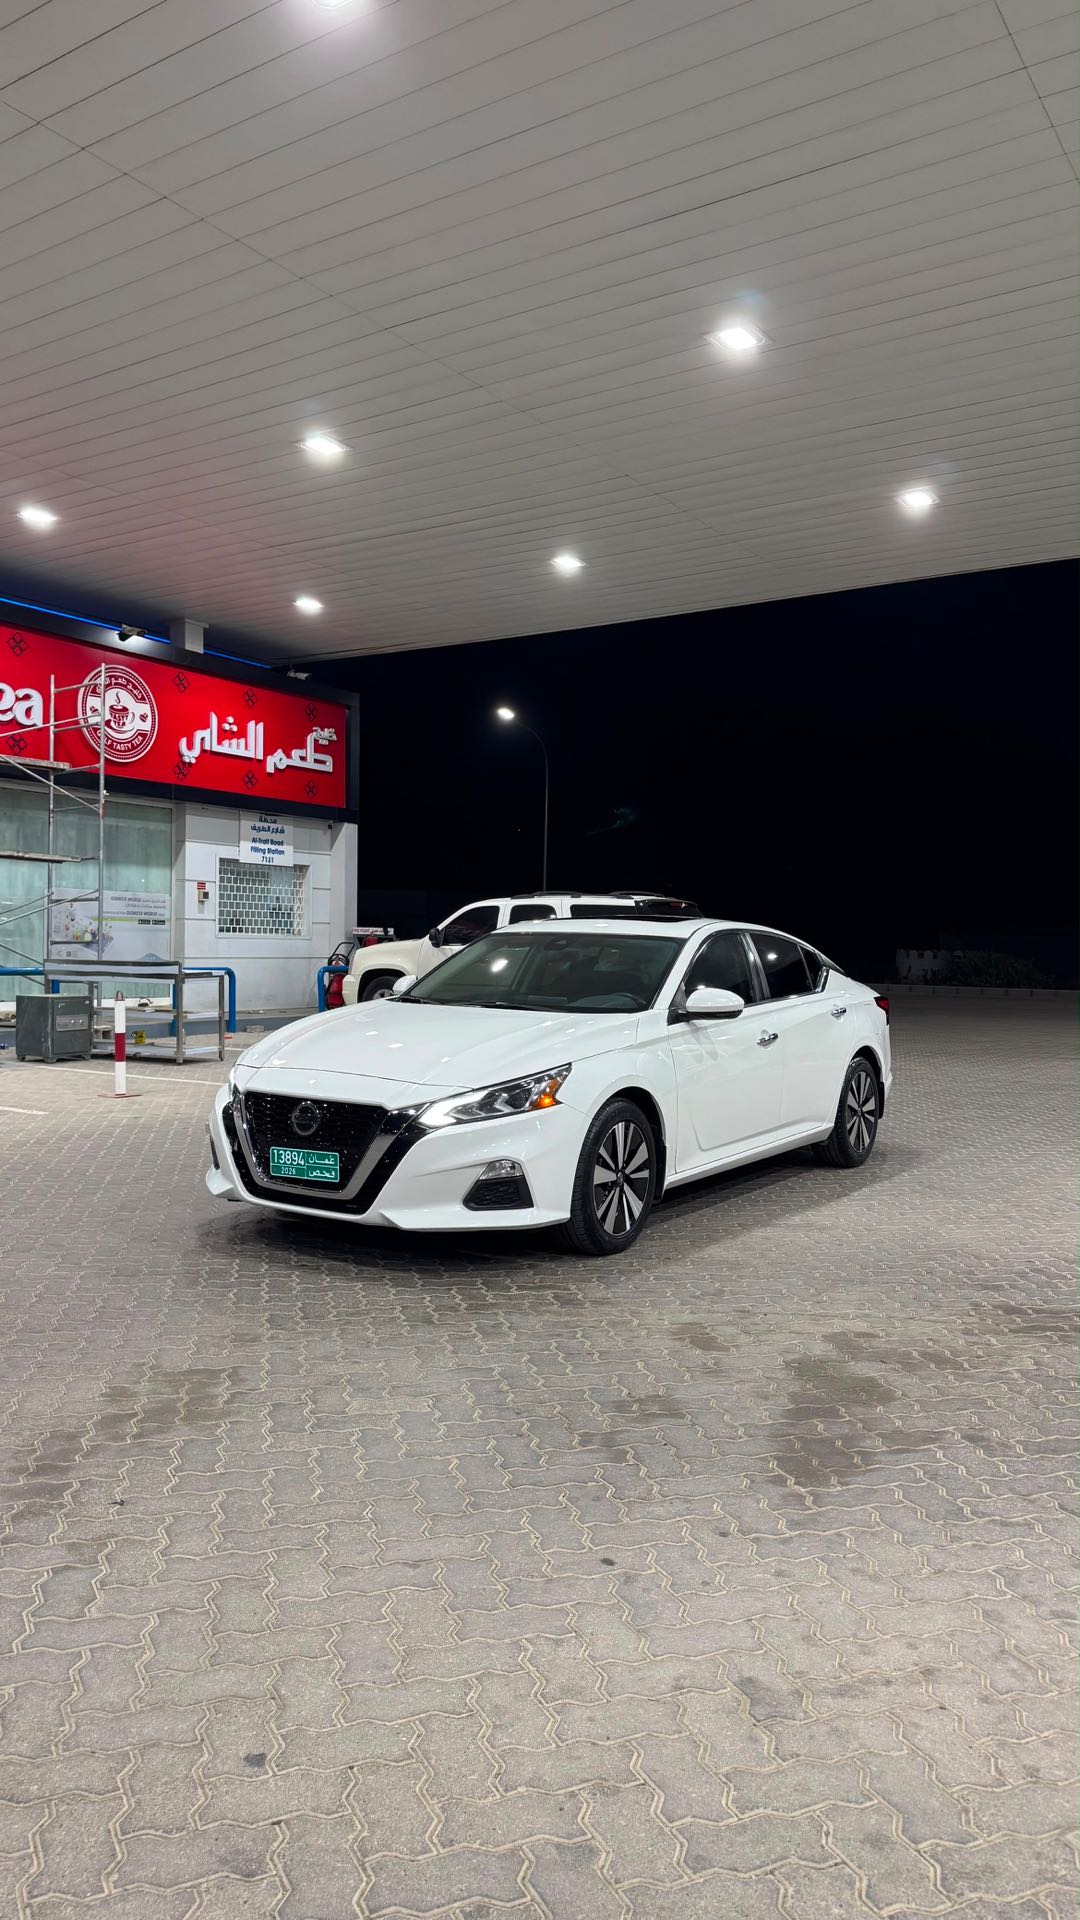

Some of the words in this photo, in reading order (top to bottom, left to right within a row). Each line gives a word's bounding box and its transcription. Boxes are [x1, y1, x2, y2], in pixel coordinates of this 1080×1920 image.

[97, 730, 112, 745] GLF
[113, 742, 132, 751] TASTY
[132, 735, 144, 746] TEA
[179, 712, 264, 764] الشاي
[267, 732, 333, 773] طعم
[259, 815, 277, 824] محطة
[270, 838, 284, 846] Road
[250, 845, 266, 855] Filling
[267, 847, 285, 855] Station
[273, 1149, 305, 1166] 13894
[281, 1166, 297, 1175] 2026
[308, 1168, 335, 1178] فحص
